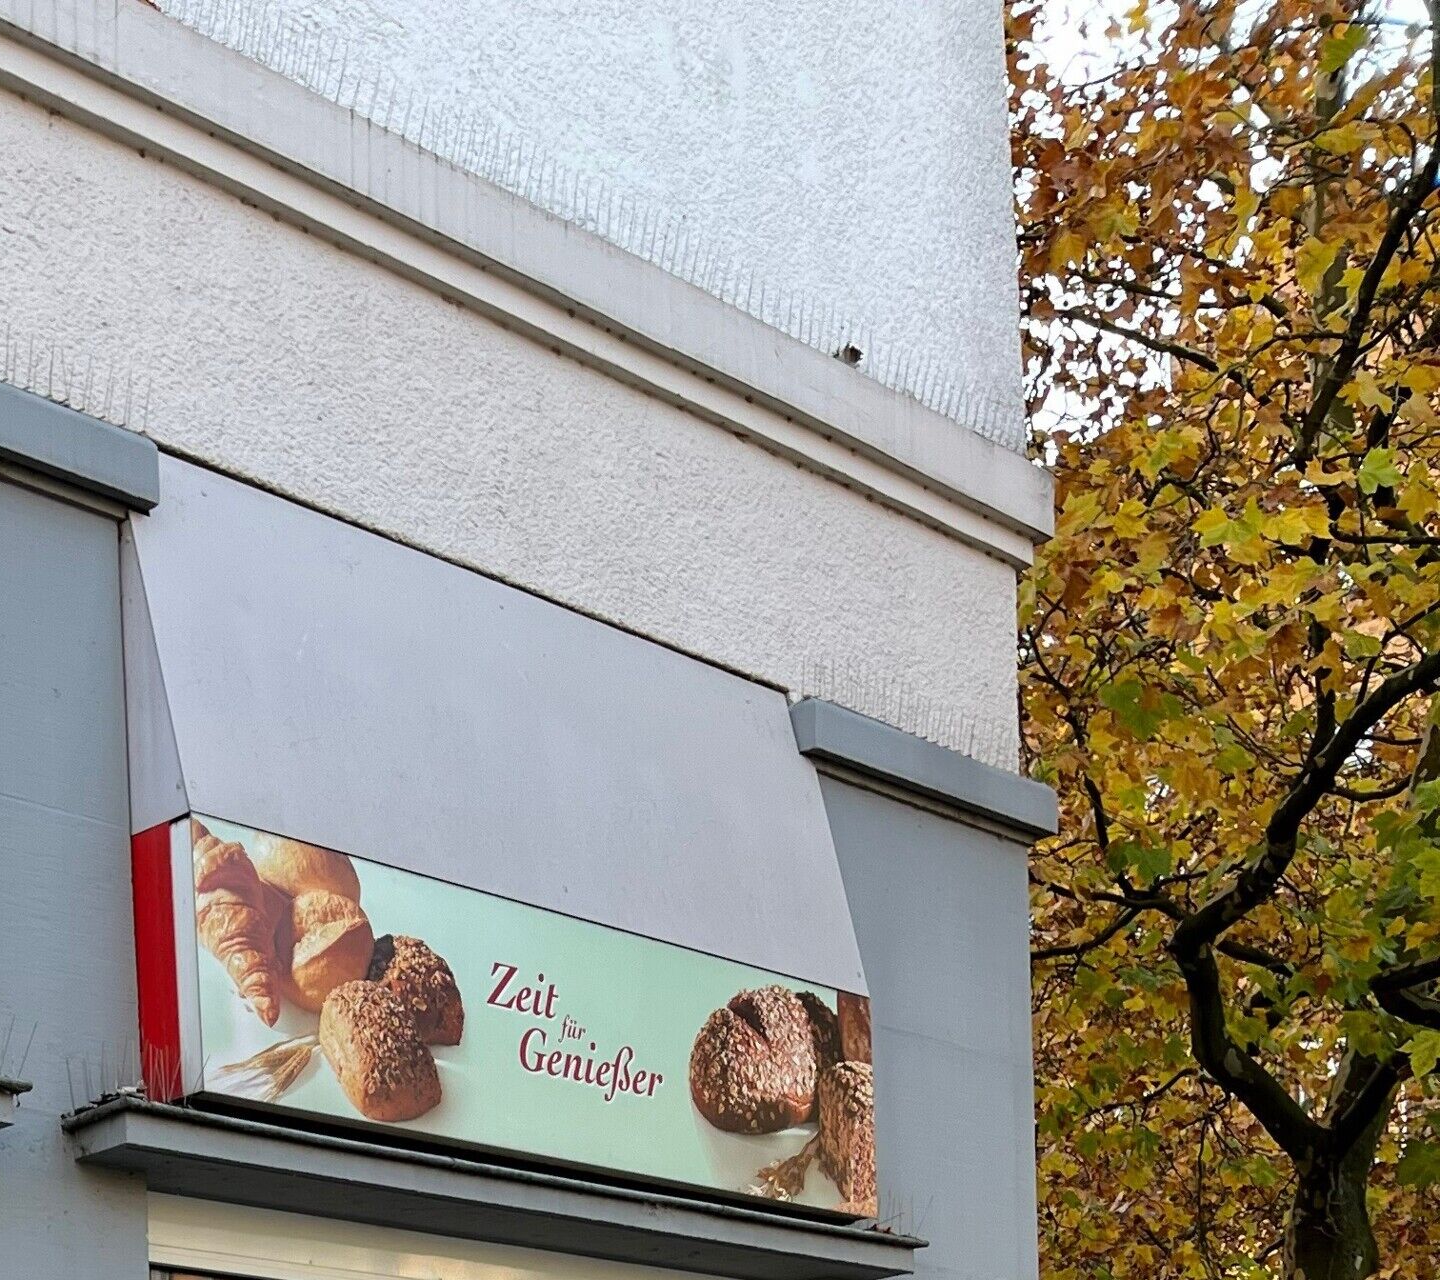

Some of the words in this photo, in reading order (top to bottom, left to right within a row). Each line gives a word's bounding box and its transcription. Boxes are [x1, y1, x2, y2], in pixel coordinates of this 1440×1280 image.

[487, 962, 559, 1019] Zeit
[558, 1014, 586, 1043] für
[519, 1028, 663, 1102] Genießer
